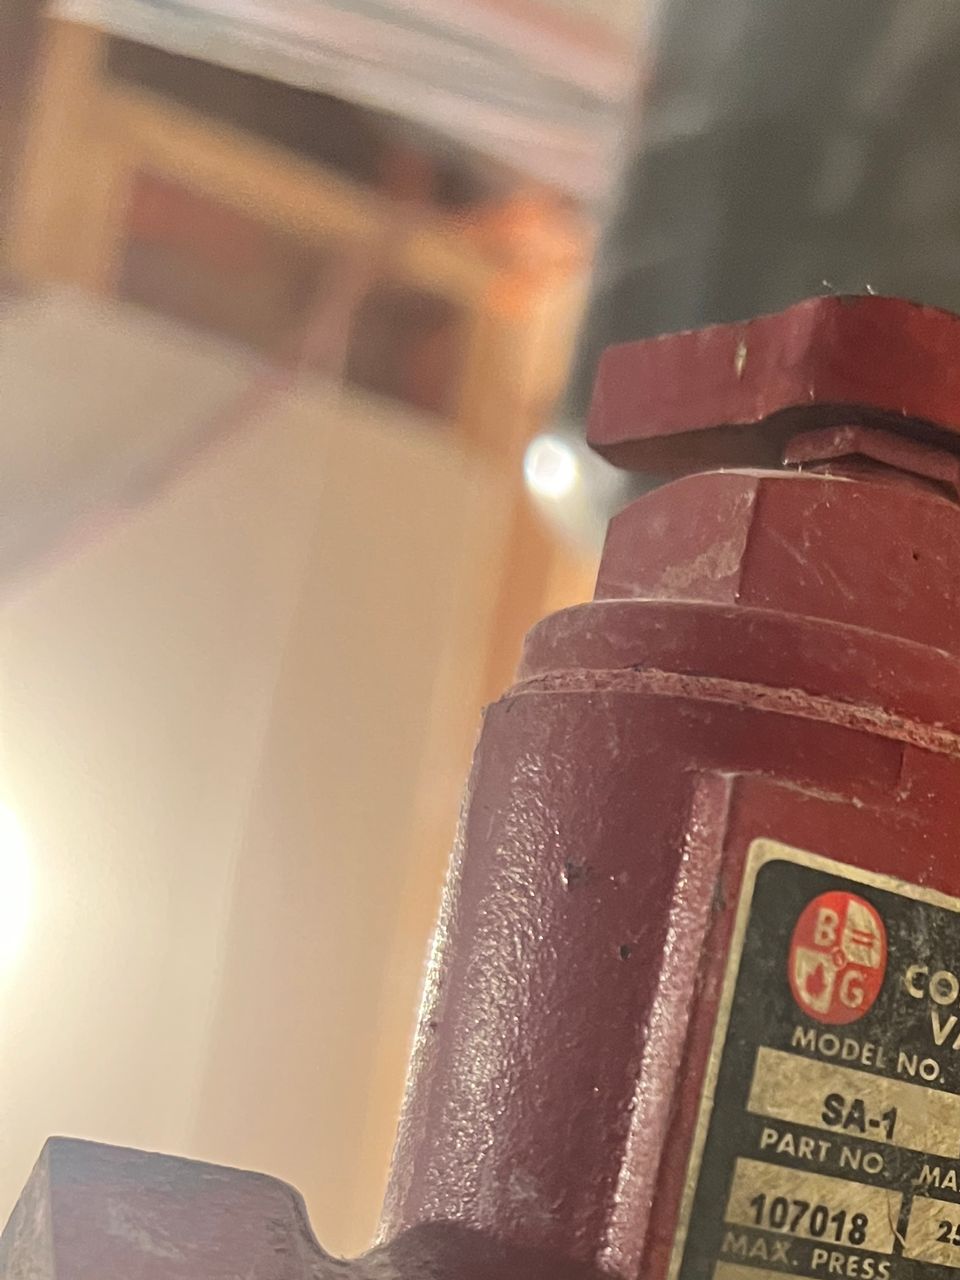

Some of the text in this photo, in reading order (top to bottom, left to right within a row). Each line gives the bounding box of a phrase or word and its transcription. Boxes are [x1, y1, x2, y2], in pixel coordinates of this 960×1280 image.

[791, 1025, 945, 1085] MODEL NO.
[821, 1093, 898, 1140] SA-1
[760, 1127, 832, 1163] PART
[749, 1193, 869, 1246] 107018
[720, 1231, 799, 1266] MAX.
